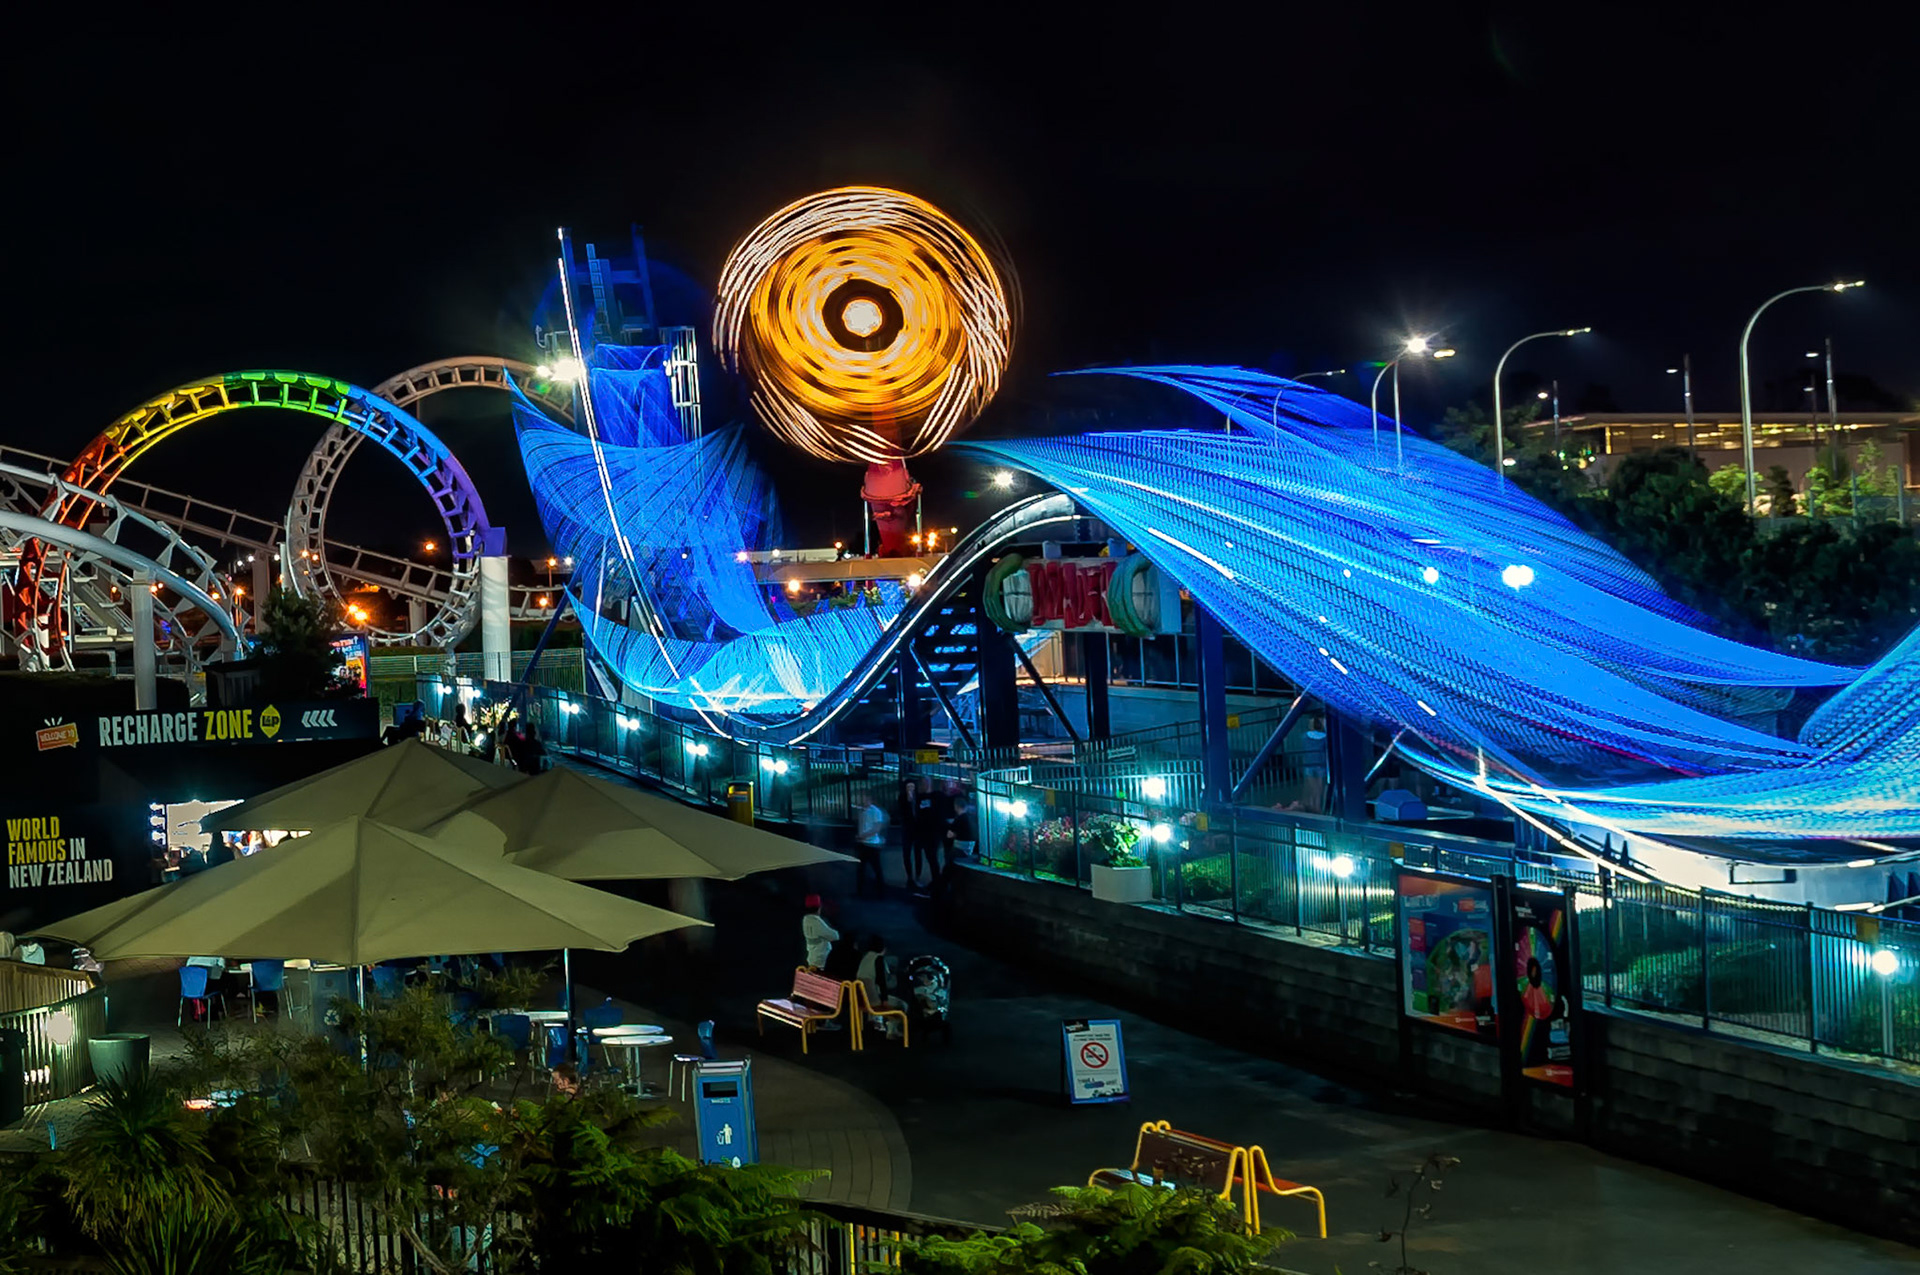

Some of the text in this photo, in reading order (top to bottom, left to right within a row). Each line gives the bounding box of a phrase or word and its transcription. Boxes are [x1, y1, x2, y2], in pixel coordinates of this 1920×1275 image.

[99, 709, 253, 747] RECHARGE ZONE
[6, 816, 60, 841] WORLD
[8, 837, 86, 865] FAMOUS IN
[9, 858, 113, 889] NEW ZEALAND
